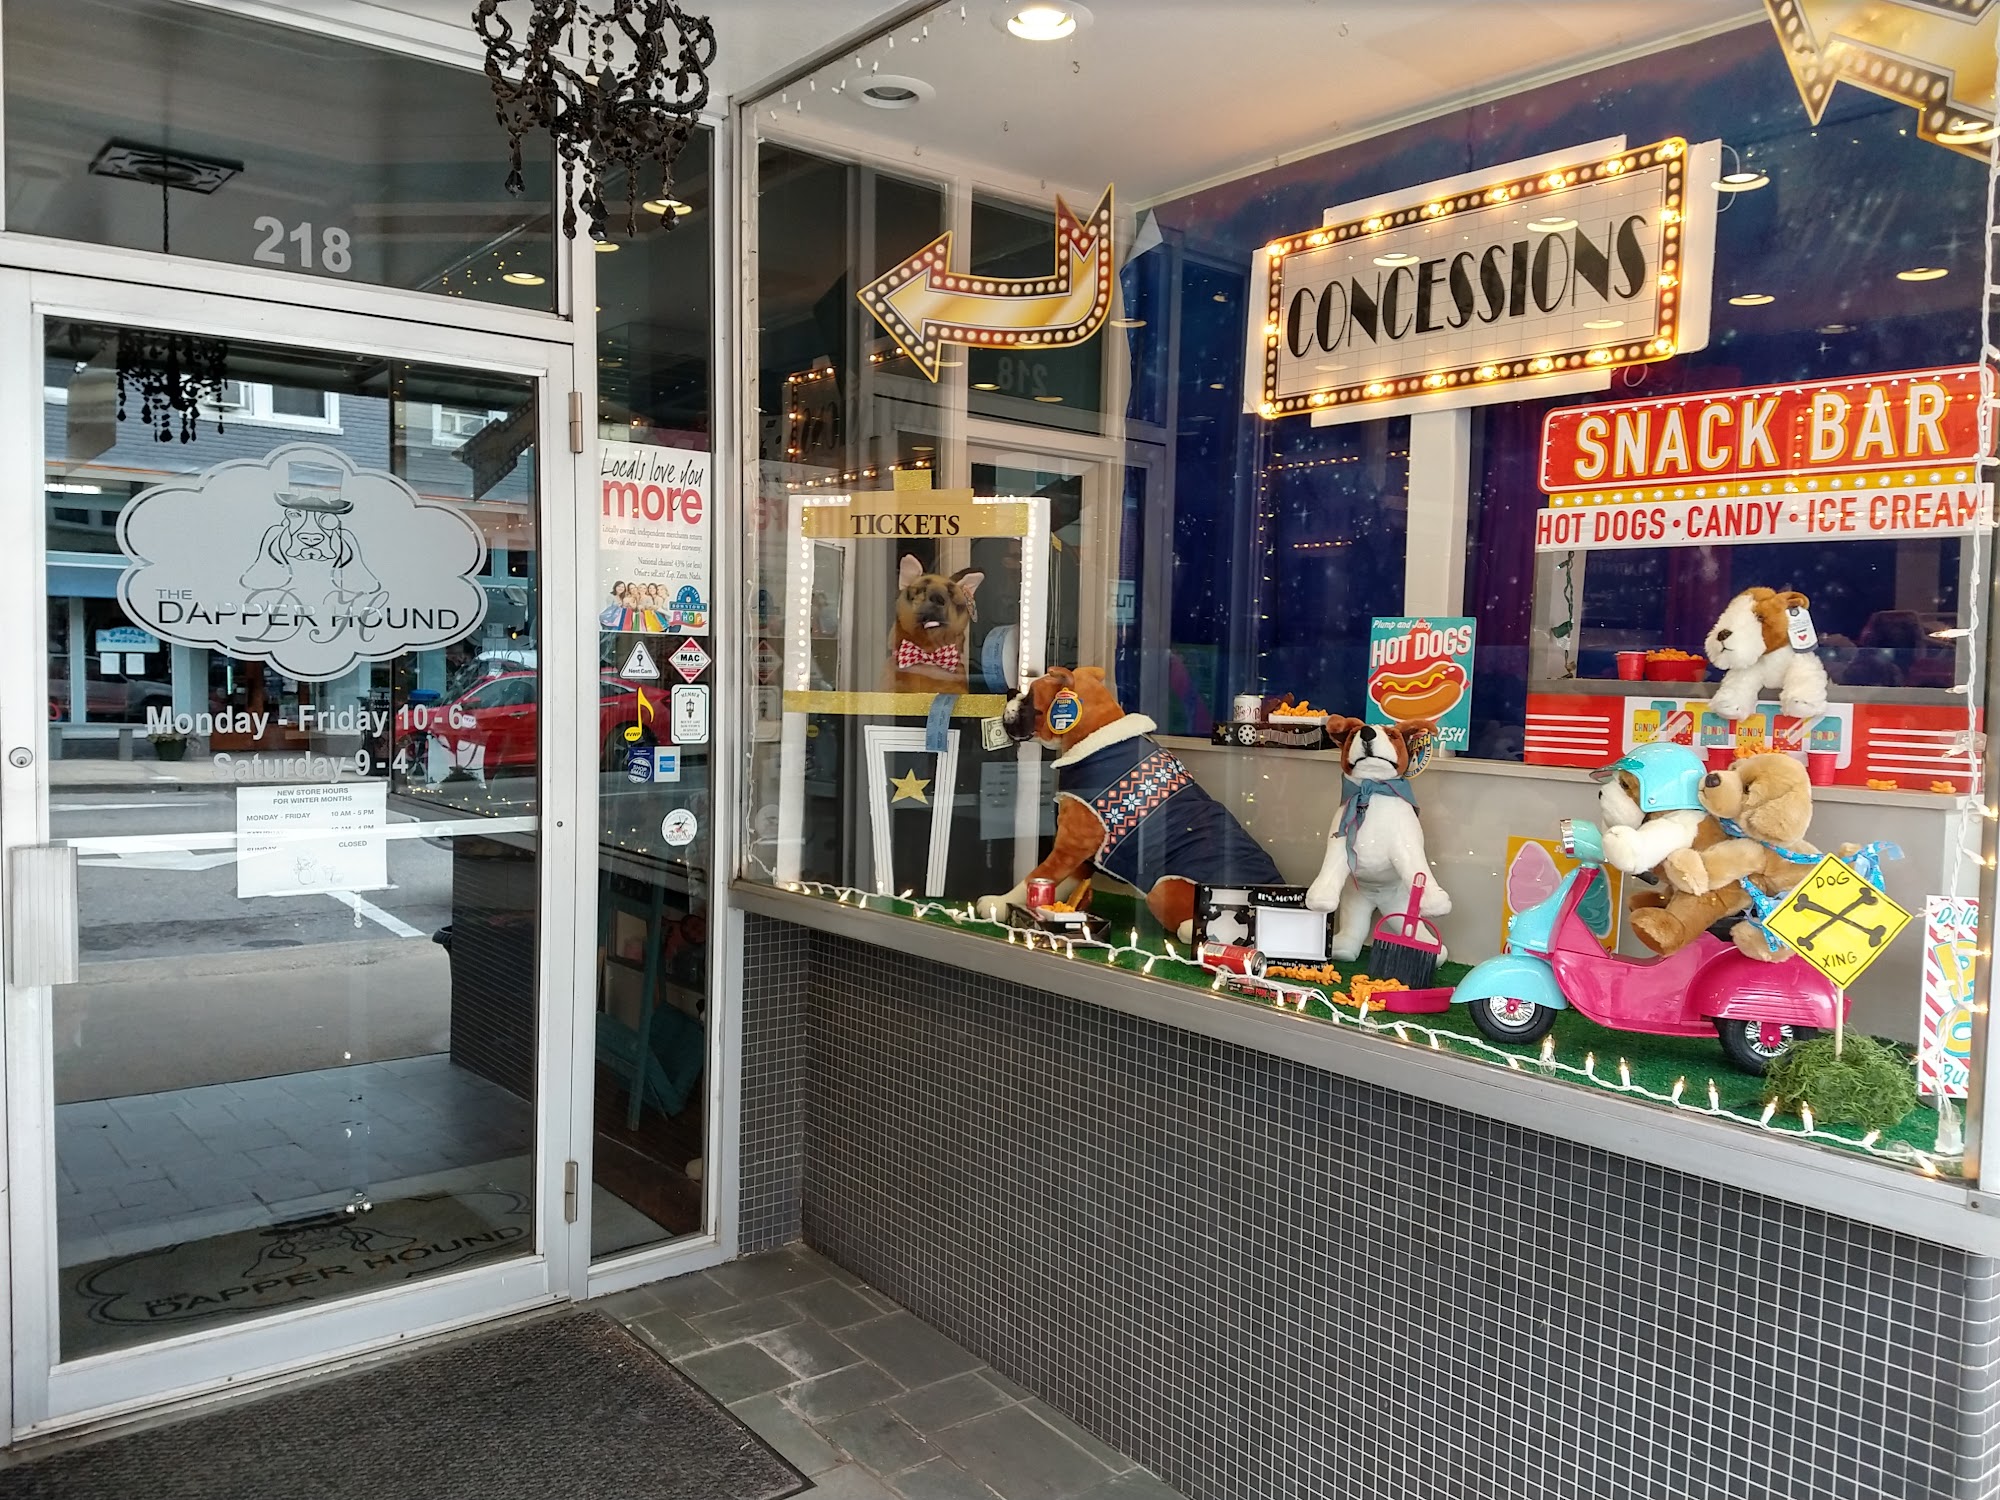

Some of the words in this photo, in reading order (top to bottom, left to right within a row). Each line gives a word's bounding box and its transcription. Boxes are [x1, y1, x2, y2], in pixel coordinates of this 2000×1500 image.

[253, 216, 352, 273] 218
[1286, 215, 1647, 358] CONCESSIONS
[1574, 396, 1781, 481] SNACK
[1809, 381, 1950, 463] BAR
[601, 448, 646, 481] Locals
[649, 452, 675, 483] love
[603, 480, 702, 524] more
[850, 514, 960, 536] TICKETS
[1537, 511, 1586, 545] HOT
[1594, 508, 1667, 542] DOGS
[1687, 501, 1784, 538] CANDY
[1807, 497, 1857, 532] ICE
[1869, 490, 1985, 530] CREAM
[155, 588, 192, 600] THE
[158, 600, 318, 627] DAPPER
[331, 606, 459, 630] HOUND
[1373, 620, 1396, 630] Plump
[1397, 620, 1412, 629] and
[1371, 634, 1412, 668] HOT
[1414, 624, 1473, 662] DOGS
[680, 654, 700, 662] MAC
[146, 705, 269, 740] Monday
[298, 704, 389, 739] Friday
[399, 703, 428, 731] 10
[449, 702, 463, 730] 6
[1634, 723, 1658, 733] CANDY
[1704, 726, 1726, 736] CANDY
[1738, 727, 1764, 737] CANDY
[1433, 726, 1466, 742] RESH
[1812, 731, 1839, 741] CANDY
[213, 752, 345, 783] Saturday
[355, 749, 370, 775] 9
[391, 748, 409, 774] 4
[338, 840, 368, 848] CLOSED
[1816, 871, 1850, 889] DOG
[1822, 951, 1857, 968] XING
[146, 1265, 354, 1318] DAPPER
[363, 1227, 524, 1270] HOUND
